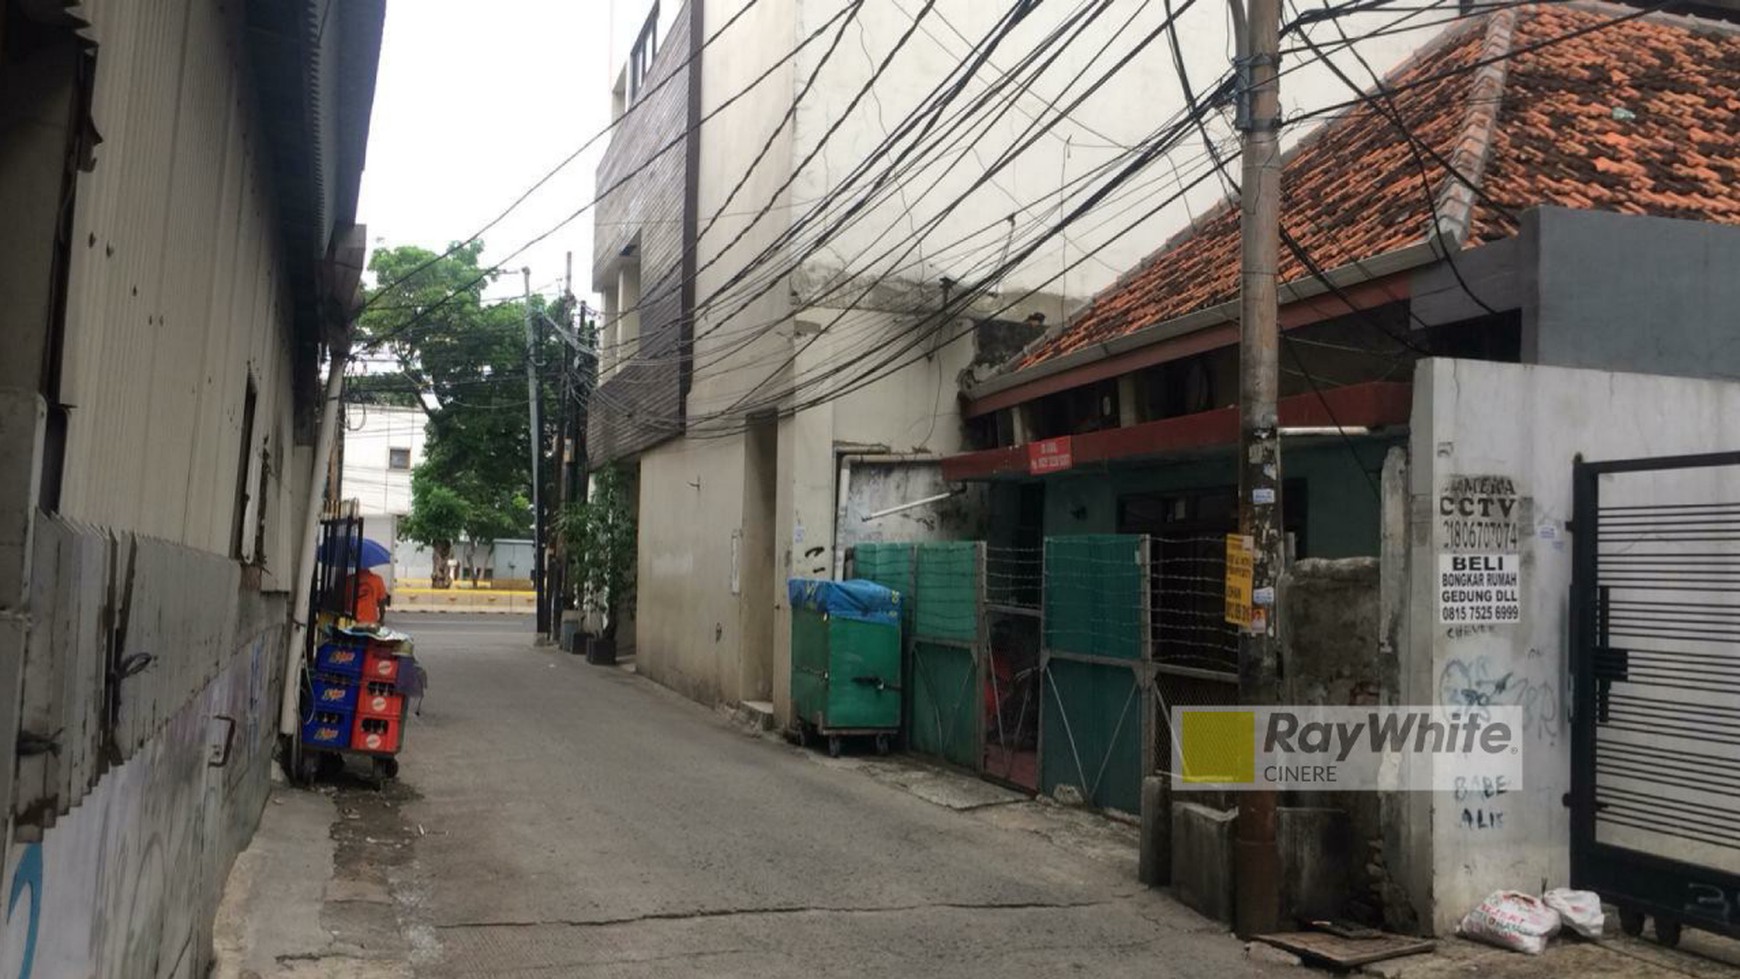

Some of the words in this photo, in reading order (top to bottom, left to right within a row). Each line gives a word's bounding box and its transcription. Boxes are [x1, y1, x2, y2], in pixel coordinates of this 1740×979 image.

[1444, 477, 1516, 495] AMERA
[1440, 497, 1517, 518] CCTV
[1452, 556, 1504, 571] BELI
[1442, 573, 1485, 587] BONGKAR
[1487, 573, 1517, 587] RUMAH
[1442, 590, 1493, 602] GEDUNG
[1496, 590, 1518, 602] DLL
[1442, 606, 1467, 620] 0815
[1469, 606, 1493, 620] 7525
[1495, 606, 1519, 620] 6999
